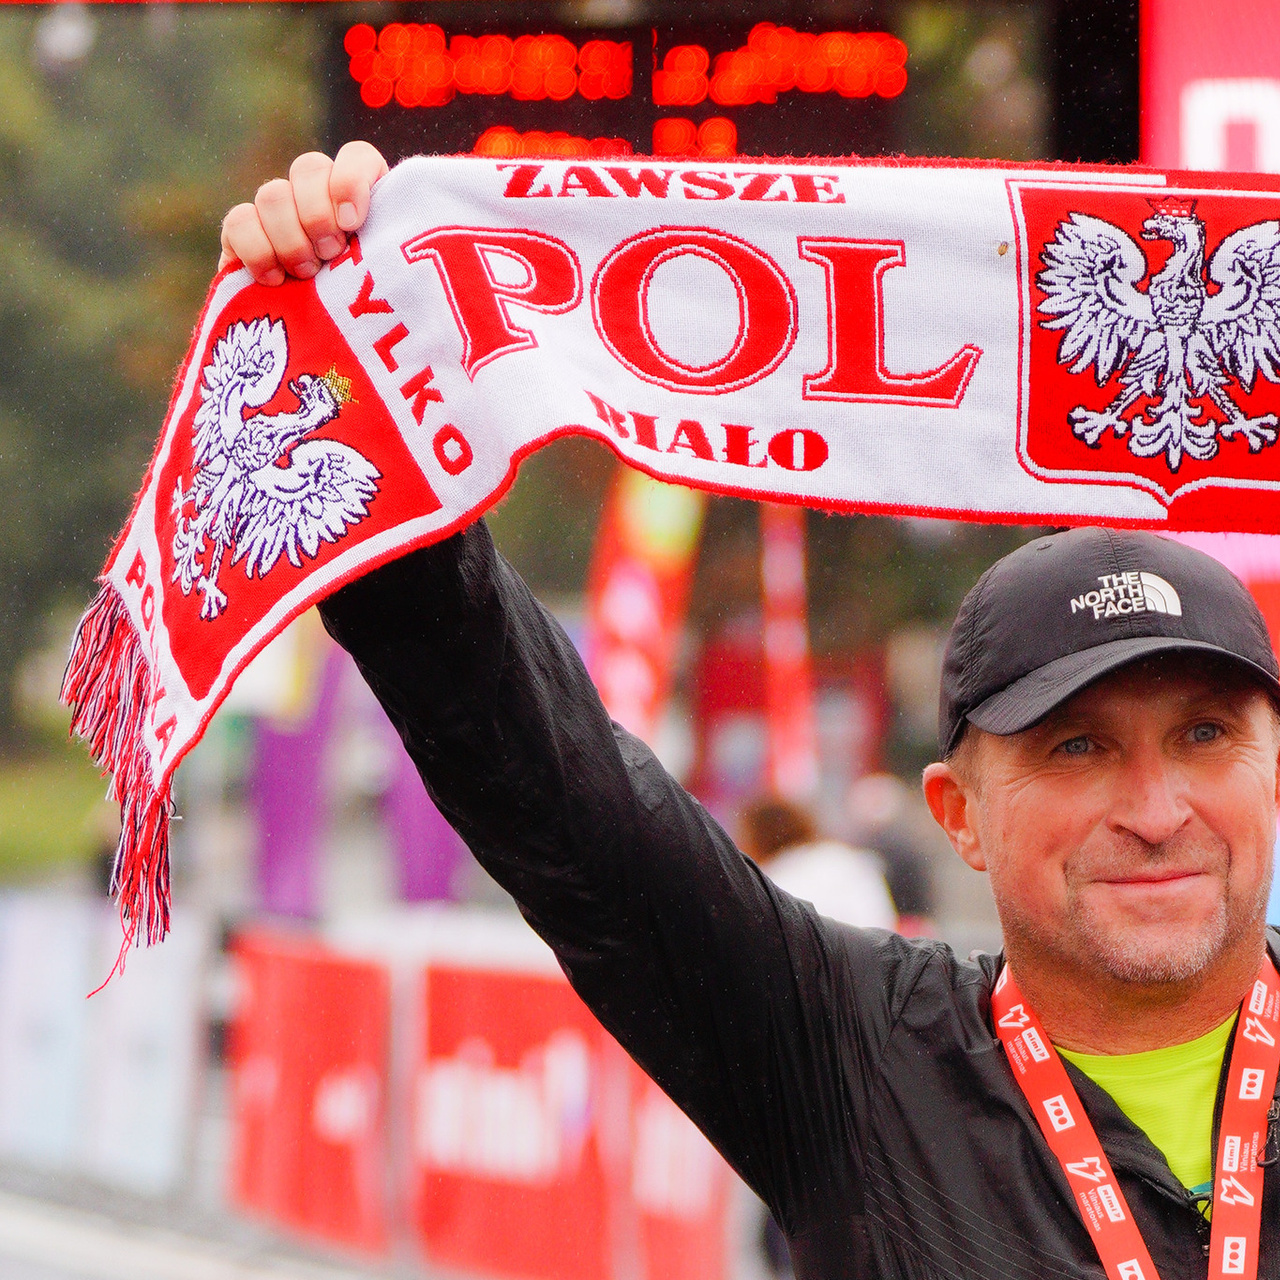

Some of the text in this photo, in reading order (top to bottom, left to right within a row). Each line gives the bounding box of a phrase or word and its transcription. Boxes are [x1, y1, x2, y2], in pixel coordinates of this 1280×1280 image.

[497, 164, 847, 203] ZAWSZE
[400, 225, 983, 408] POL
[1098, 571, 1140, 588] THE
[1070, 584, 1143, 614] NORTH
[1093, 597, 1146, 620] FACE
